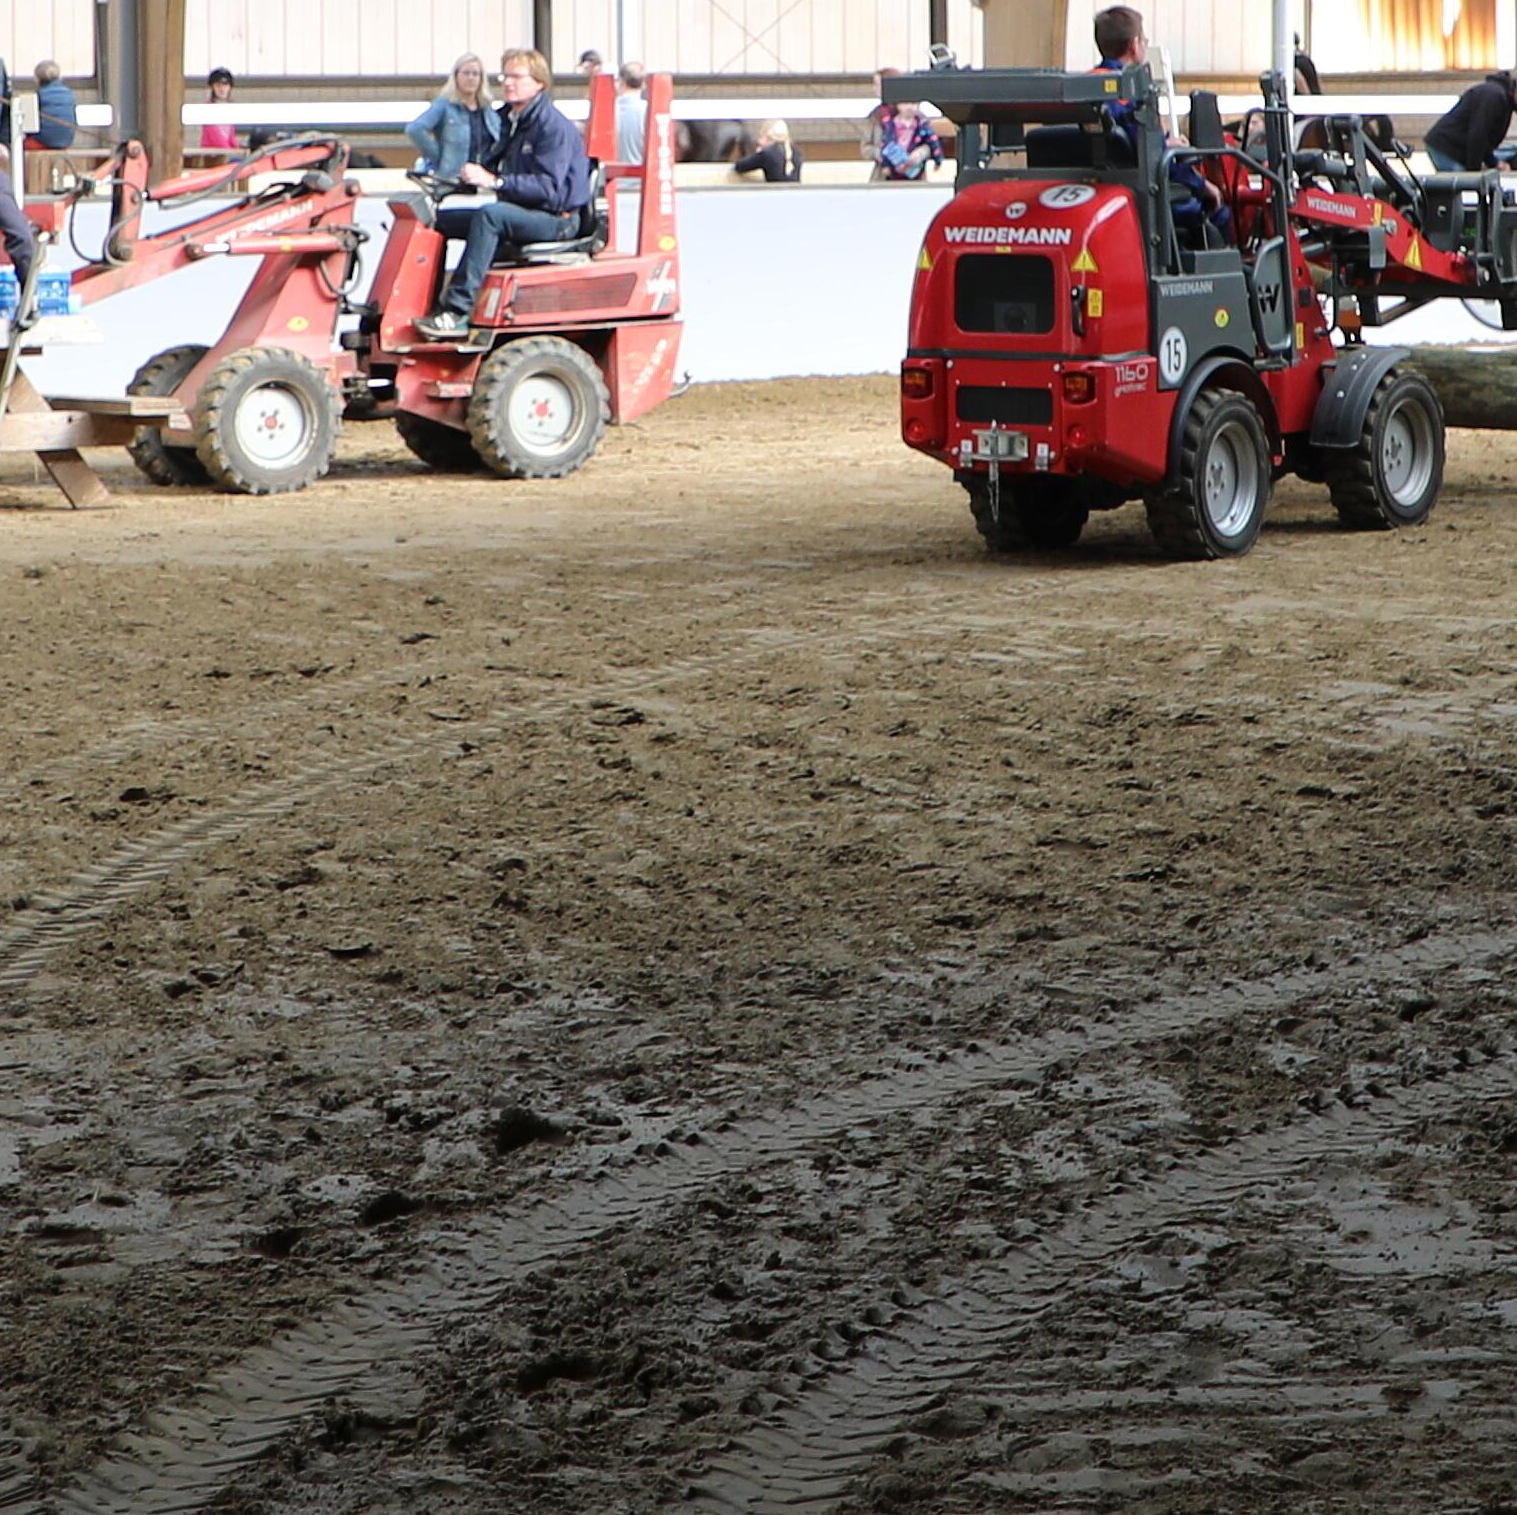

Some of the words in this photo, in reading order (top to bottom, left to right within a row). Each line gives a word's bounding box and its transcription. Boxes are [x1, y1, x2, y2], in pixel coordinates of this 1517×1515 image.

[1052, 188, 1082, 203] 15
[1307, 196, 1356, 219] WEIDEMANN
[944, 226, 1072, 244] WEIDEMANN
[1159, 281, 1214, 297] WEIDEMANN
[1166, 338, 1181, 372] 15
